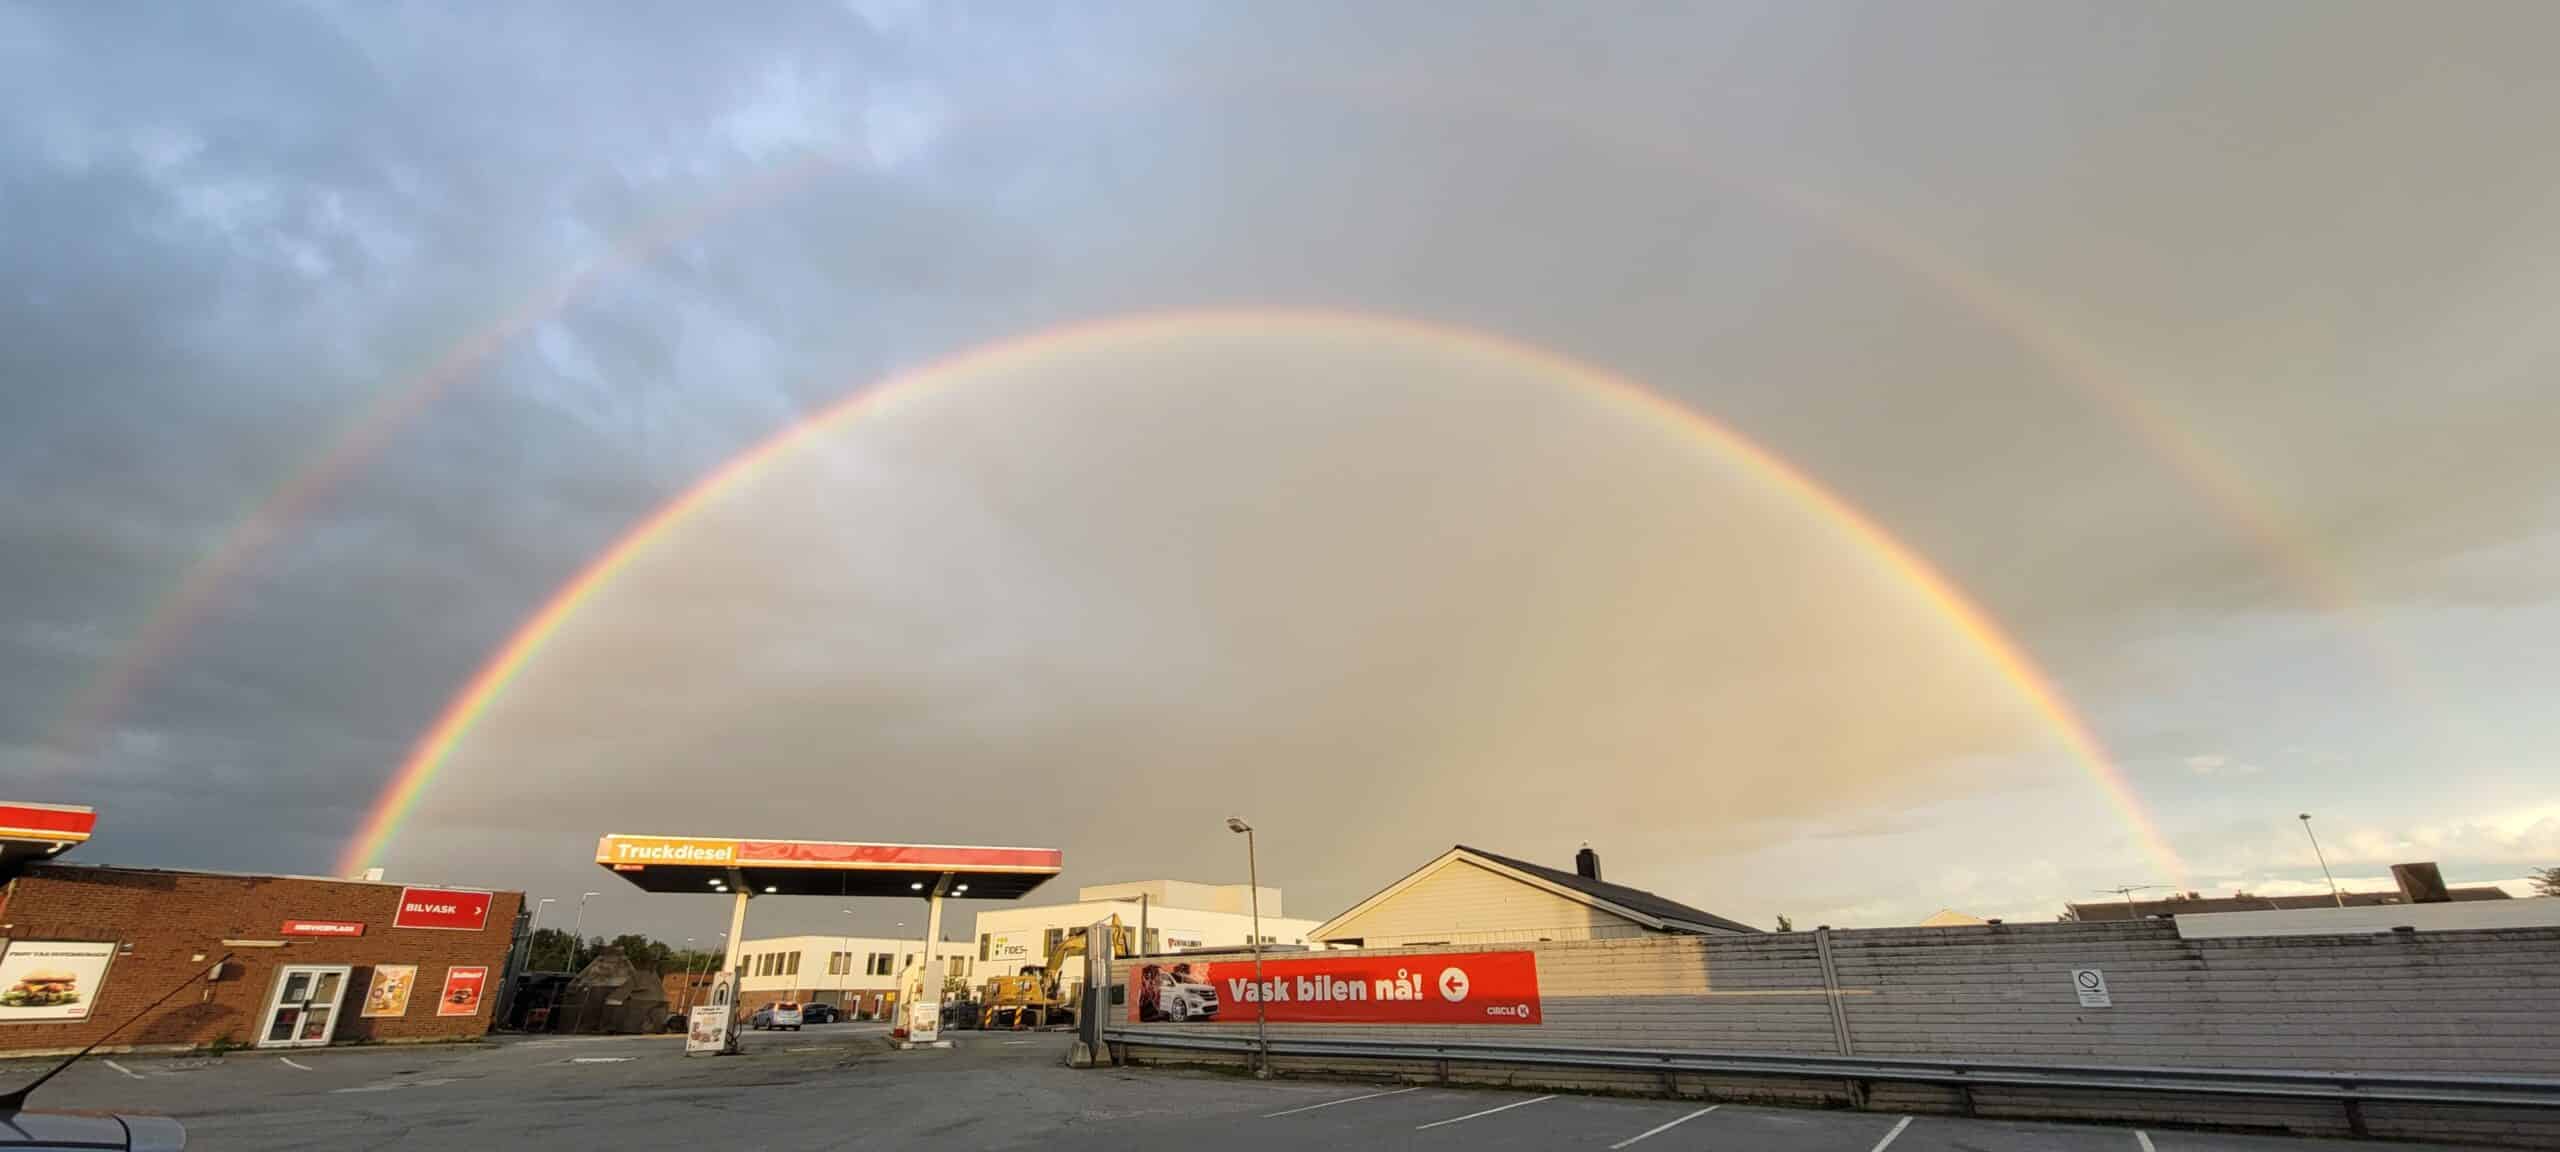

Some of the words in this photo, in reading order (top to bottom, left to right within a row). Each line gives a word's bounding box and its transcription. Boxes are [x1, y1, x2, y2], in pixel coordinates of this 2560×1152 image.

[617, 844, 732, 860] Truckdiesel
[405, 903, 457, 914] BILVASK
[1228, 976, 1290, 1002] Vask
[1296, 975, 1367, 1001] bilen
[1375, 968, 1423, 1001] nå!
[1487, 1006, 1516, 1015] CIRCLE
